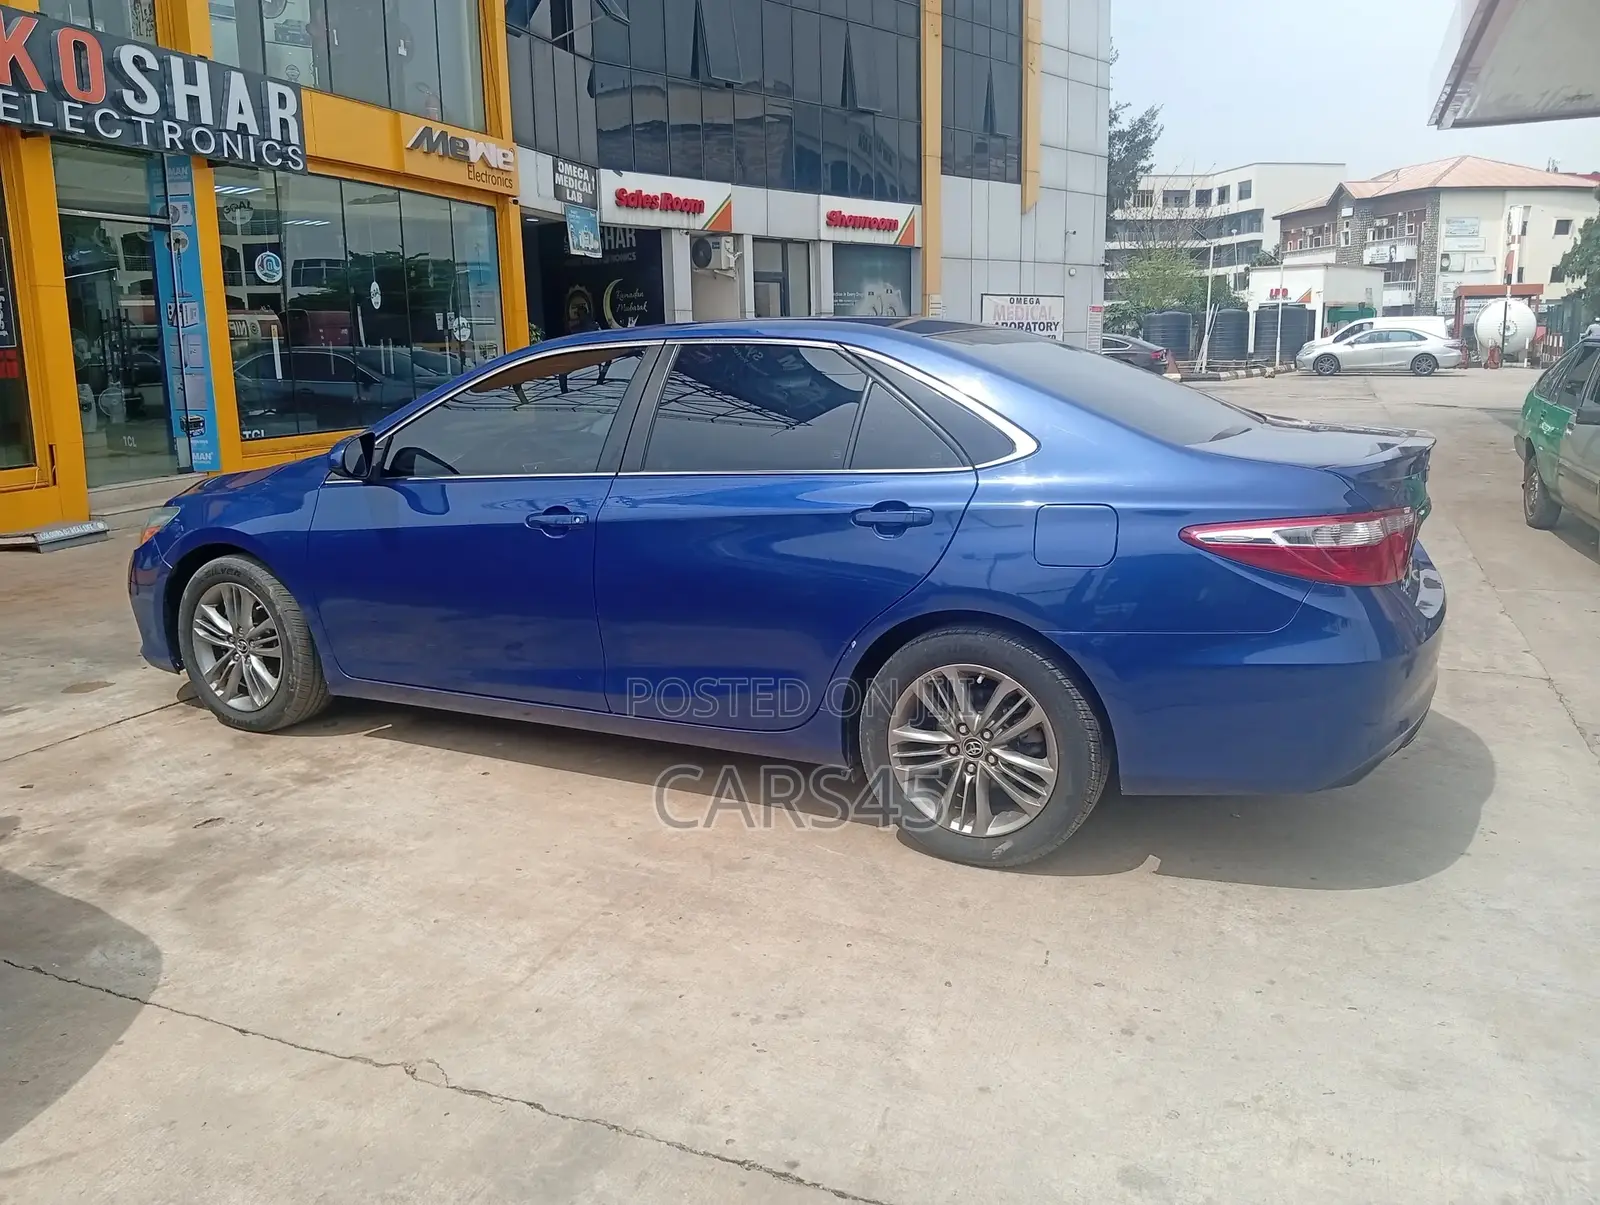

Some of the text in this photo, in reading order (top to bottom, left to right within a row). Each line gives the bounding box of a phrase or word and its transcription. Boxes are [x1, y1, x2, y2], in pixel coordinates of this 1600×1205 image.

[0, 9, 300, 145] KOSHAR
[0, 88, 304, 171] ELECTRONICS
[467, 164, 513, 189] Electronics
[557, 161, 589, 182] OMEGA
[555, 173, 593, 195] MEDICAL
[566, 189, 583, 203] LAB
[615, 188, 705, 214] Sales Room
[826, 205, 899, 231] Showroom
[1009, 297, 1041, 305] OMEGA
[993, 305, 1056, 321] MEDICAL
[994, 321, 1060, 332] BORATORY
[123, 435, 137, 447] TCL
[192, 453, 212, 461] MAN
